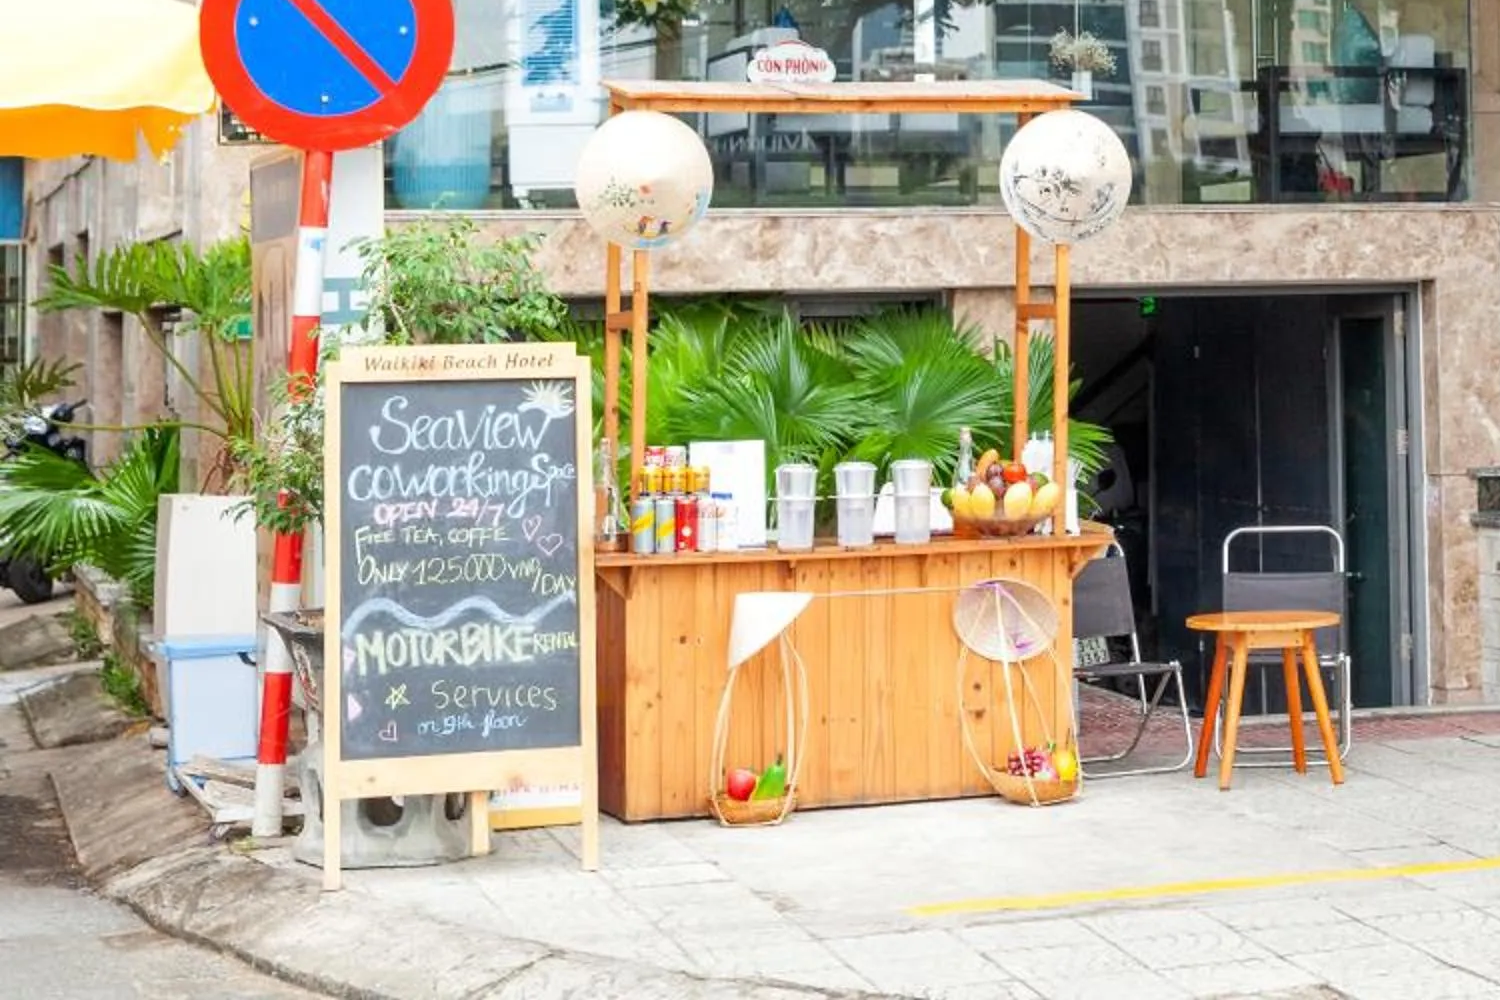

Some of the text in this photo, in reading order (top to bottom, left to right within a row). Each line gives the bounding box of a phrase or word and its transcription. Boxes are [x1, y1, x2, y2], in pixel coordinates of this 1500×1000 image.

[364, 351, 555, 372] Waikiki Beach Hotel
[374, 496, 505, 528] OPEN 24/7
[355, 620, 536, 676] MOTORBIKE
[431, 679, 557, 711] Services
